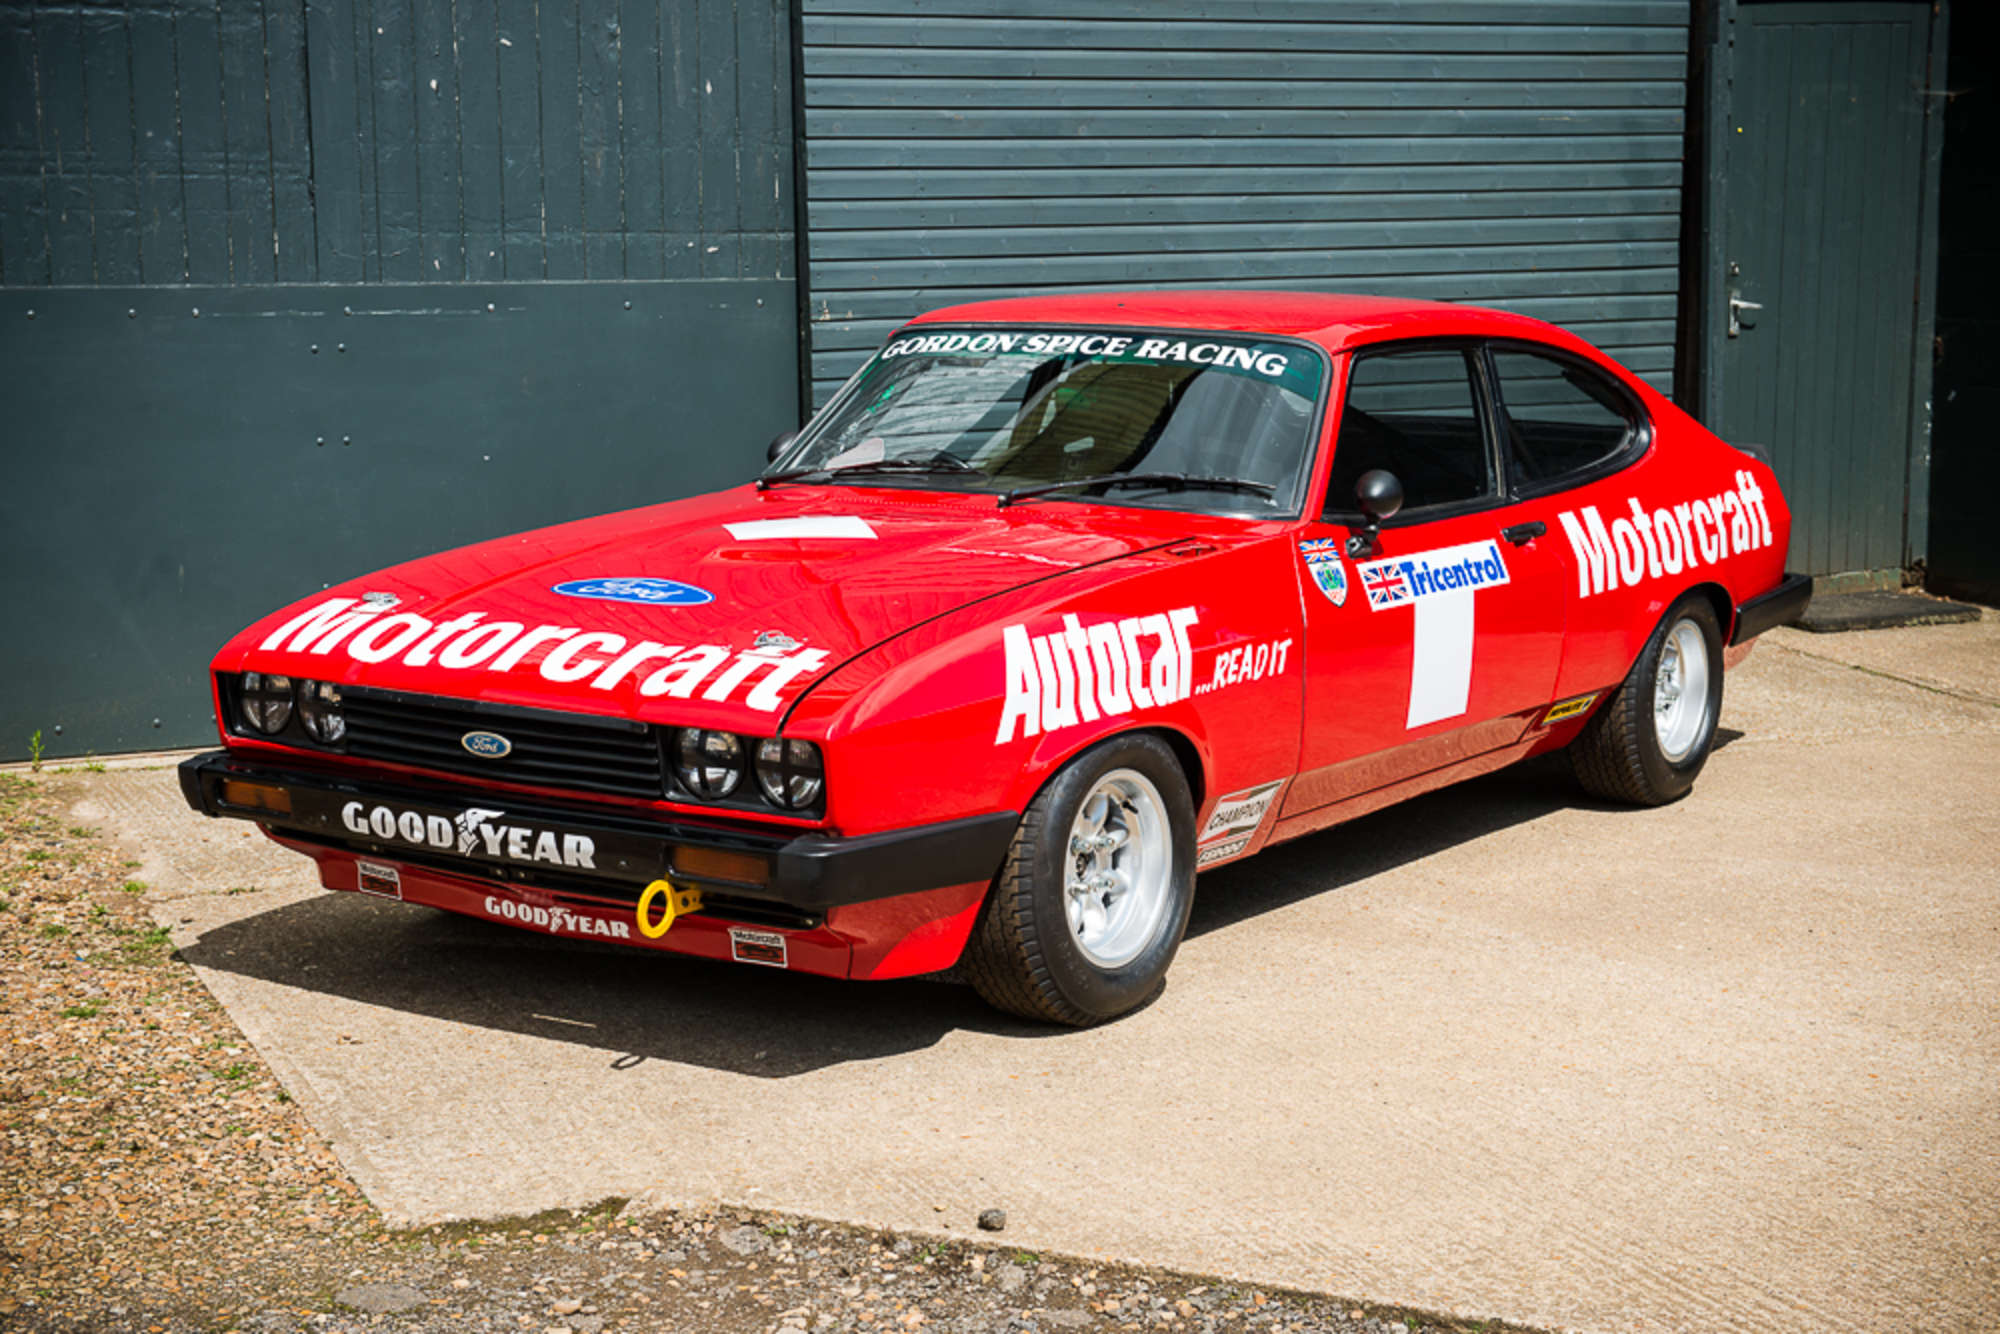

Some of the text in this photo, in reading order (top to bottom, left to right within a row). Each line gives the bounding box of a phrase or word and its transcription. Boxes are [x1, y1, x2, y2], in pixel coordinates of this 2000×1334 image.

[881, 333, 1289, 377] GORDON SPICE RACING
[1398, 545, 1505, 597] Tricentrol
[1557, 469, 1772, 599] Motorcraft
[258, 591, 831, 713] Motorcraft
[994, 606, 1199, 745] Autocar
[732, 930, 782, 945] Motorcraft
